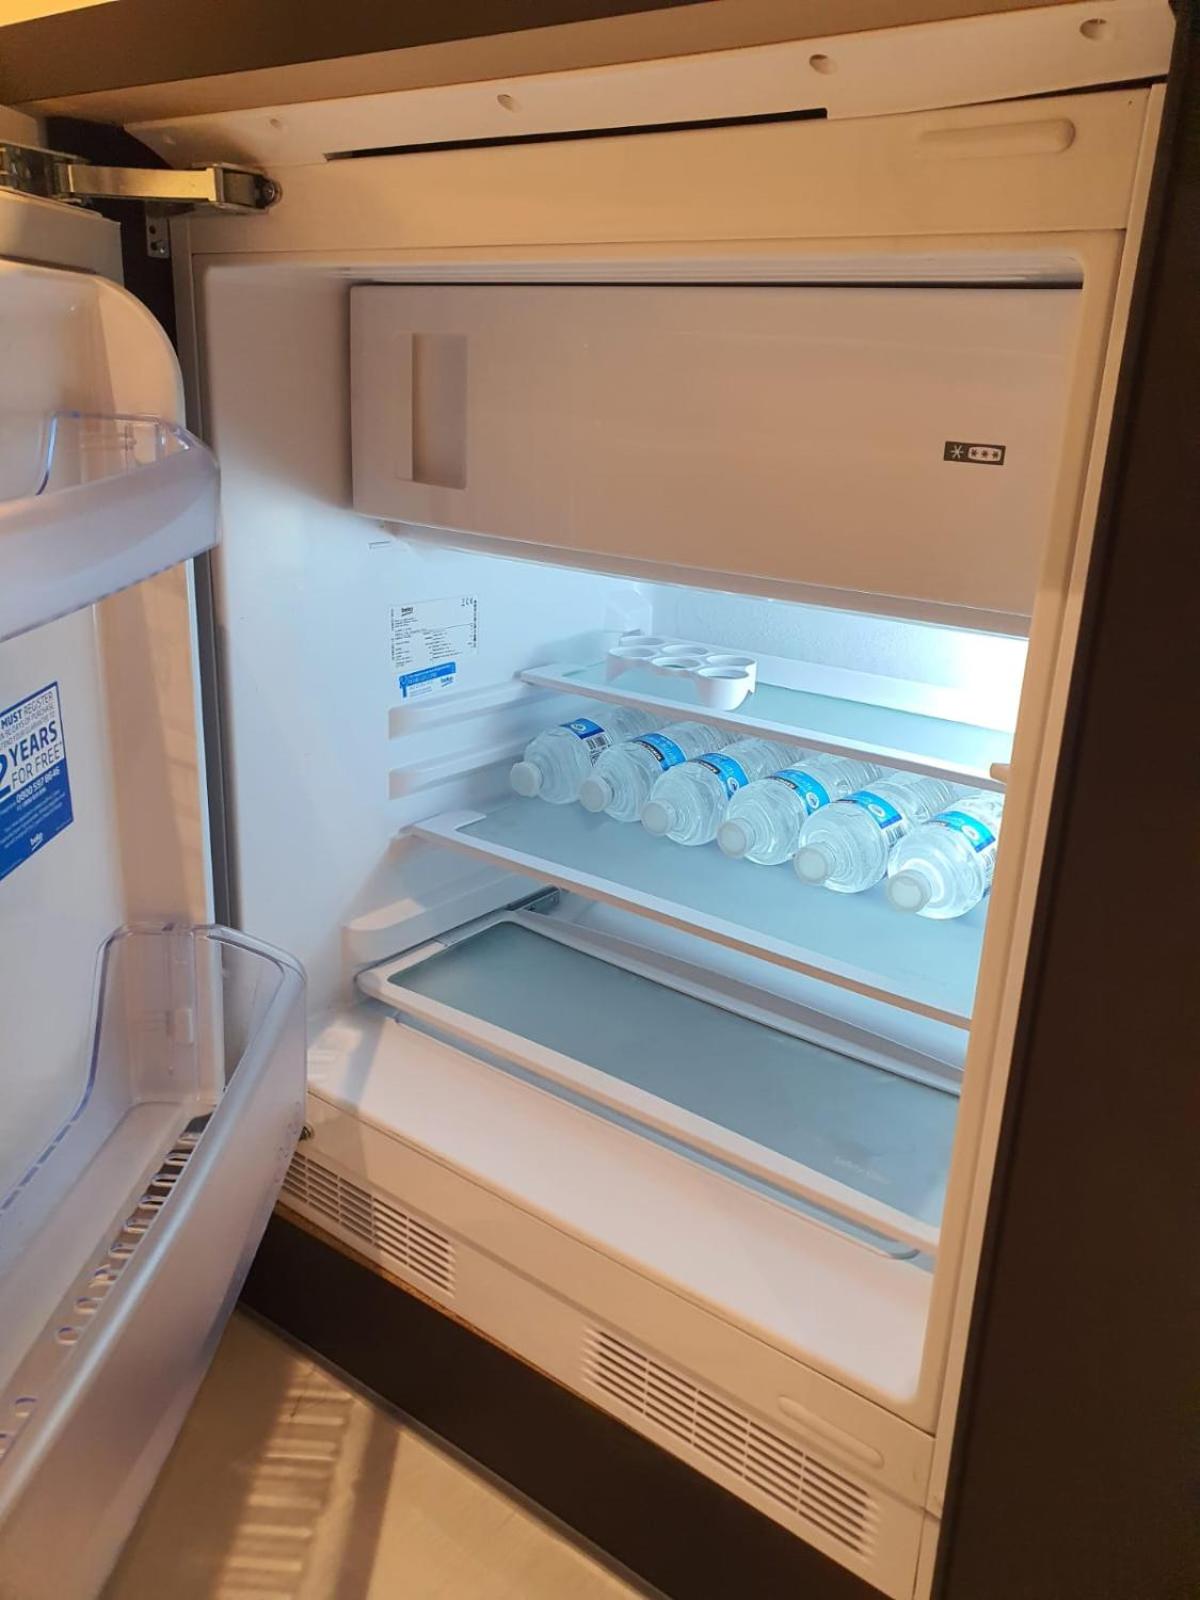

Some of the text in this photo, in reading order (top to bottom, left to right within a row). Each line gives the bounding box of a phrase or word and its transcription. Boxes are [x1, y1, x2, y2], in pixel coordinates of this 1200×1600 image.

[1, 709, 22, 729] MUST
[23, 691, 53, 715] REGISTER
[9, 720, 58, 767] YEARS
[12, 763, 33, 788] FOR
